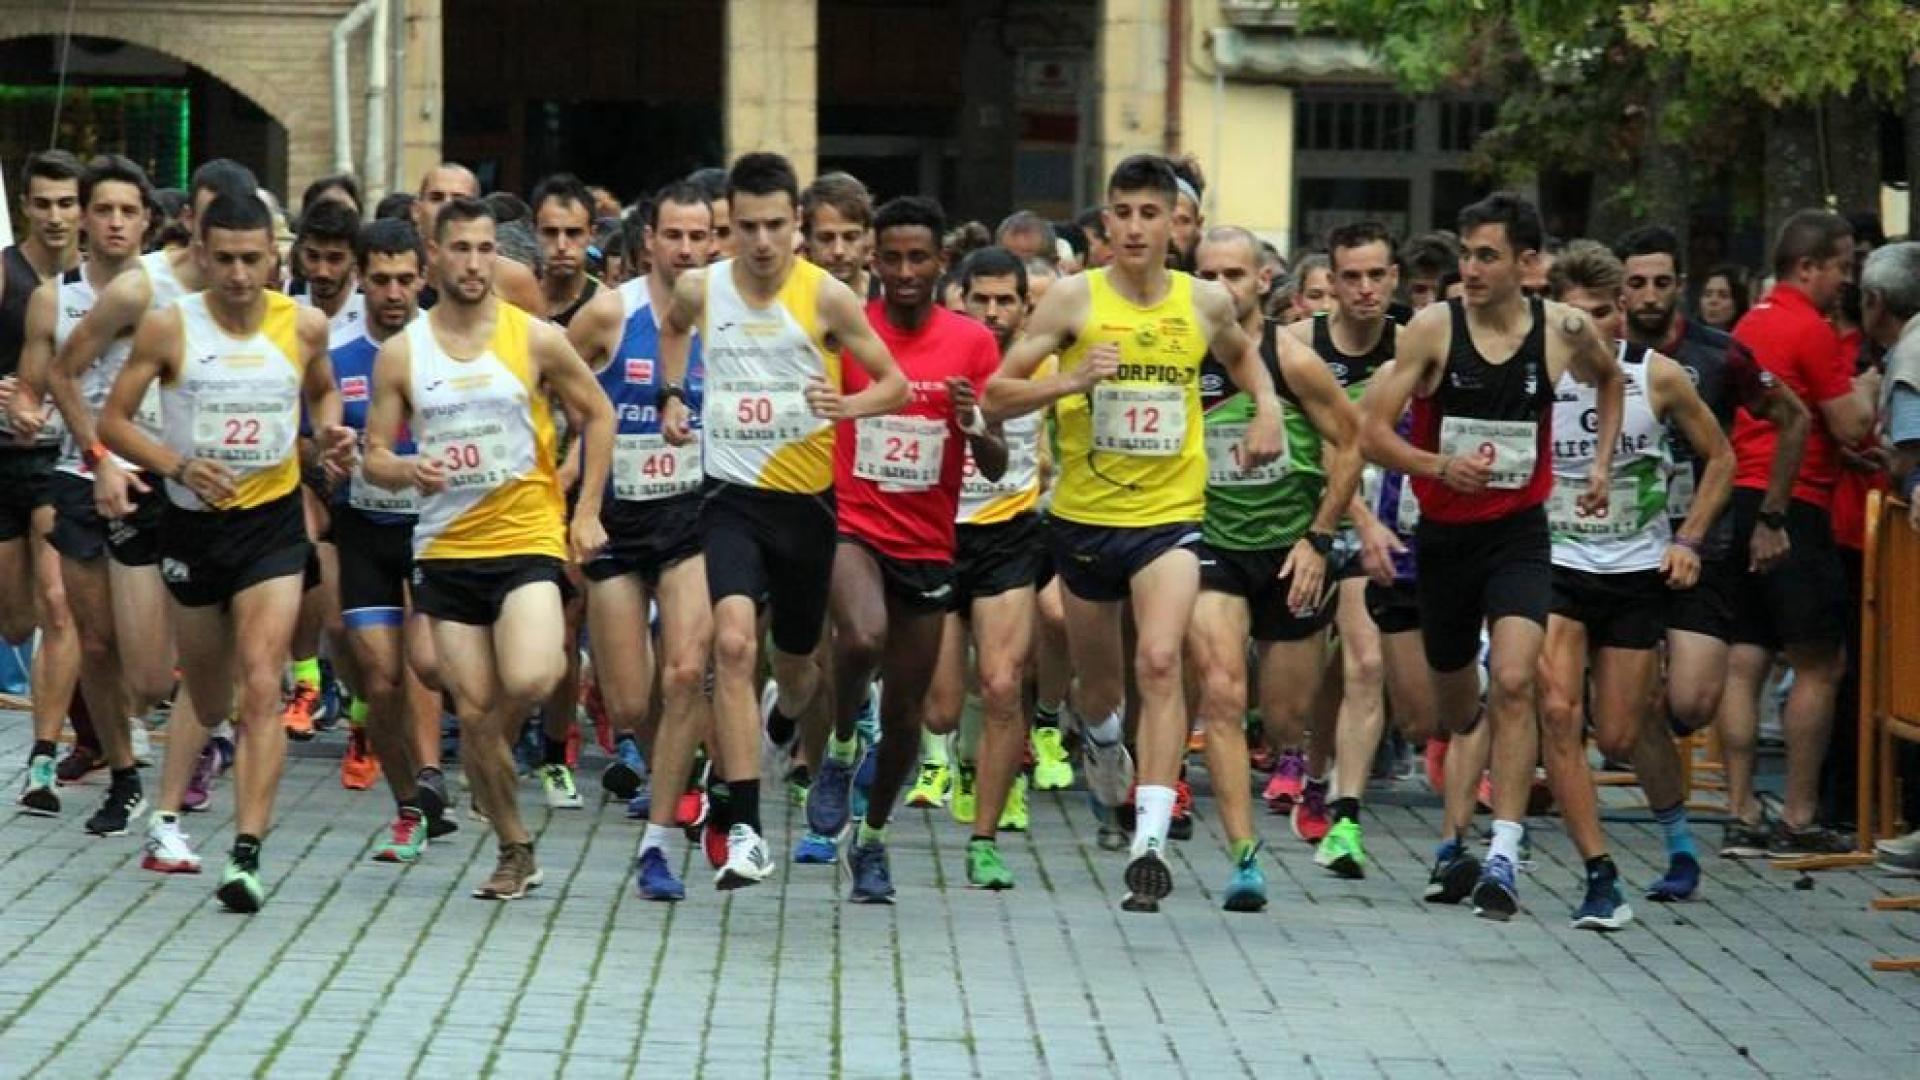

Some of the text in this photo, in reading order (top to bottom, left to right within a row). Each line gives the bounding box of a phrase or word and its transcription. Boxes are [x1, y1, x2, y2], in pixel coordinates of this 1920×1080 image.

[738, 397, 773, 424] 50
[1124, 407, 1160, 433] 12
[223, 419, 261, 445] 22
[445, 443, 481, 470] 30
[884, 437, 920, 464] 24
[642, 453, 676, 479] 40
